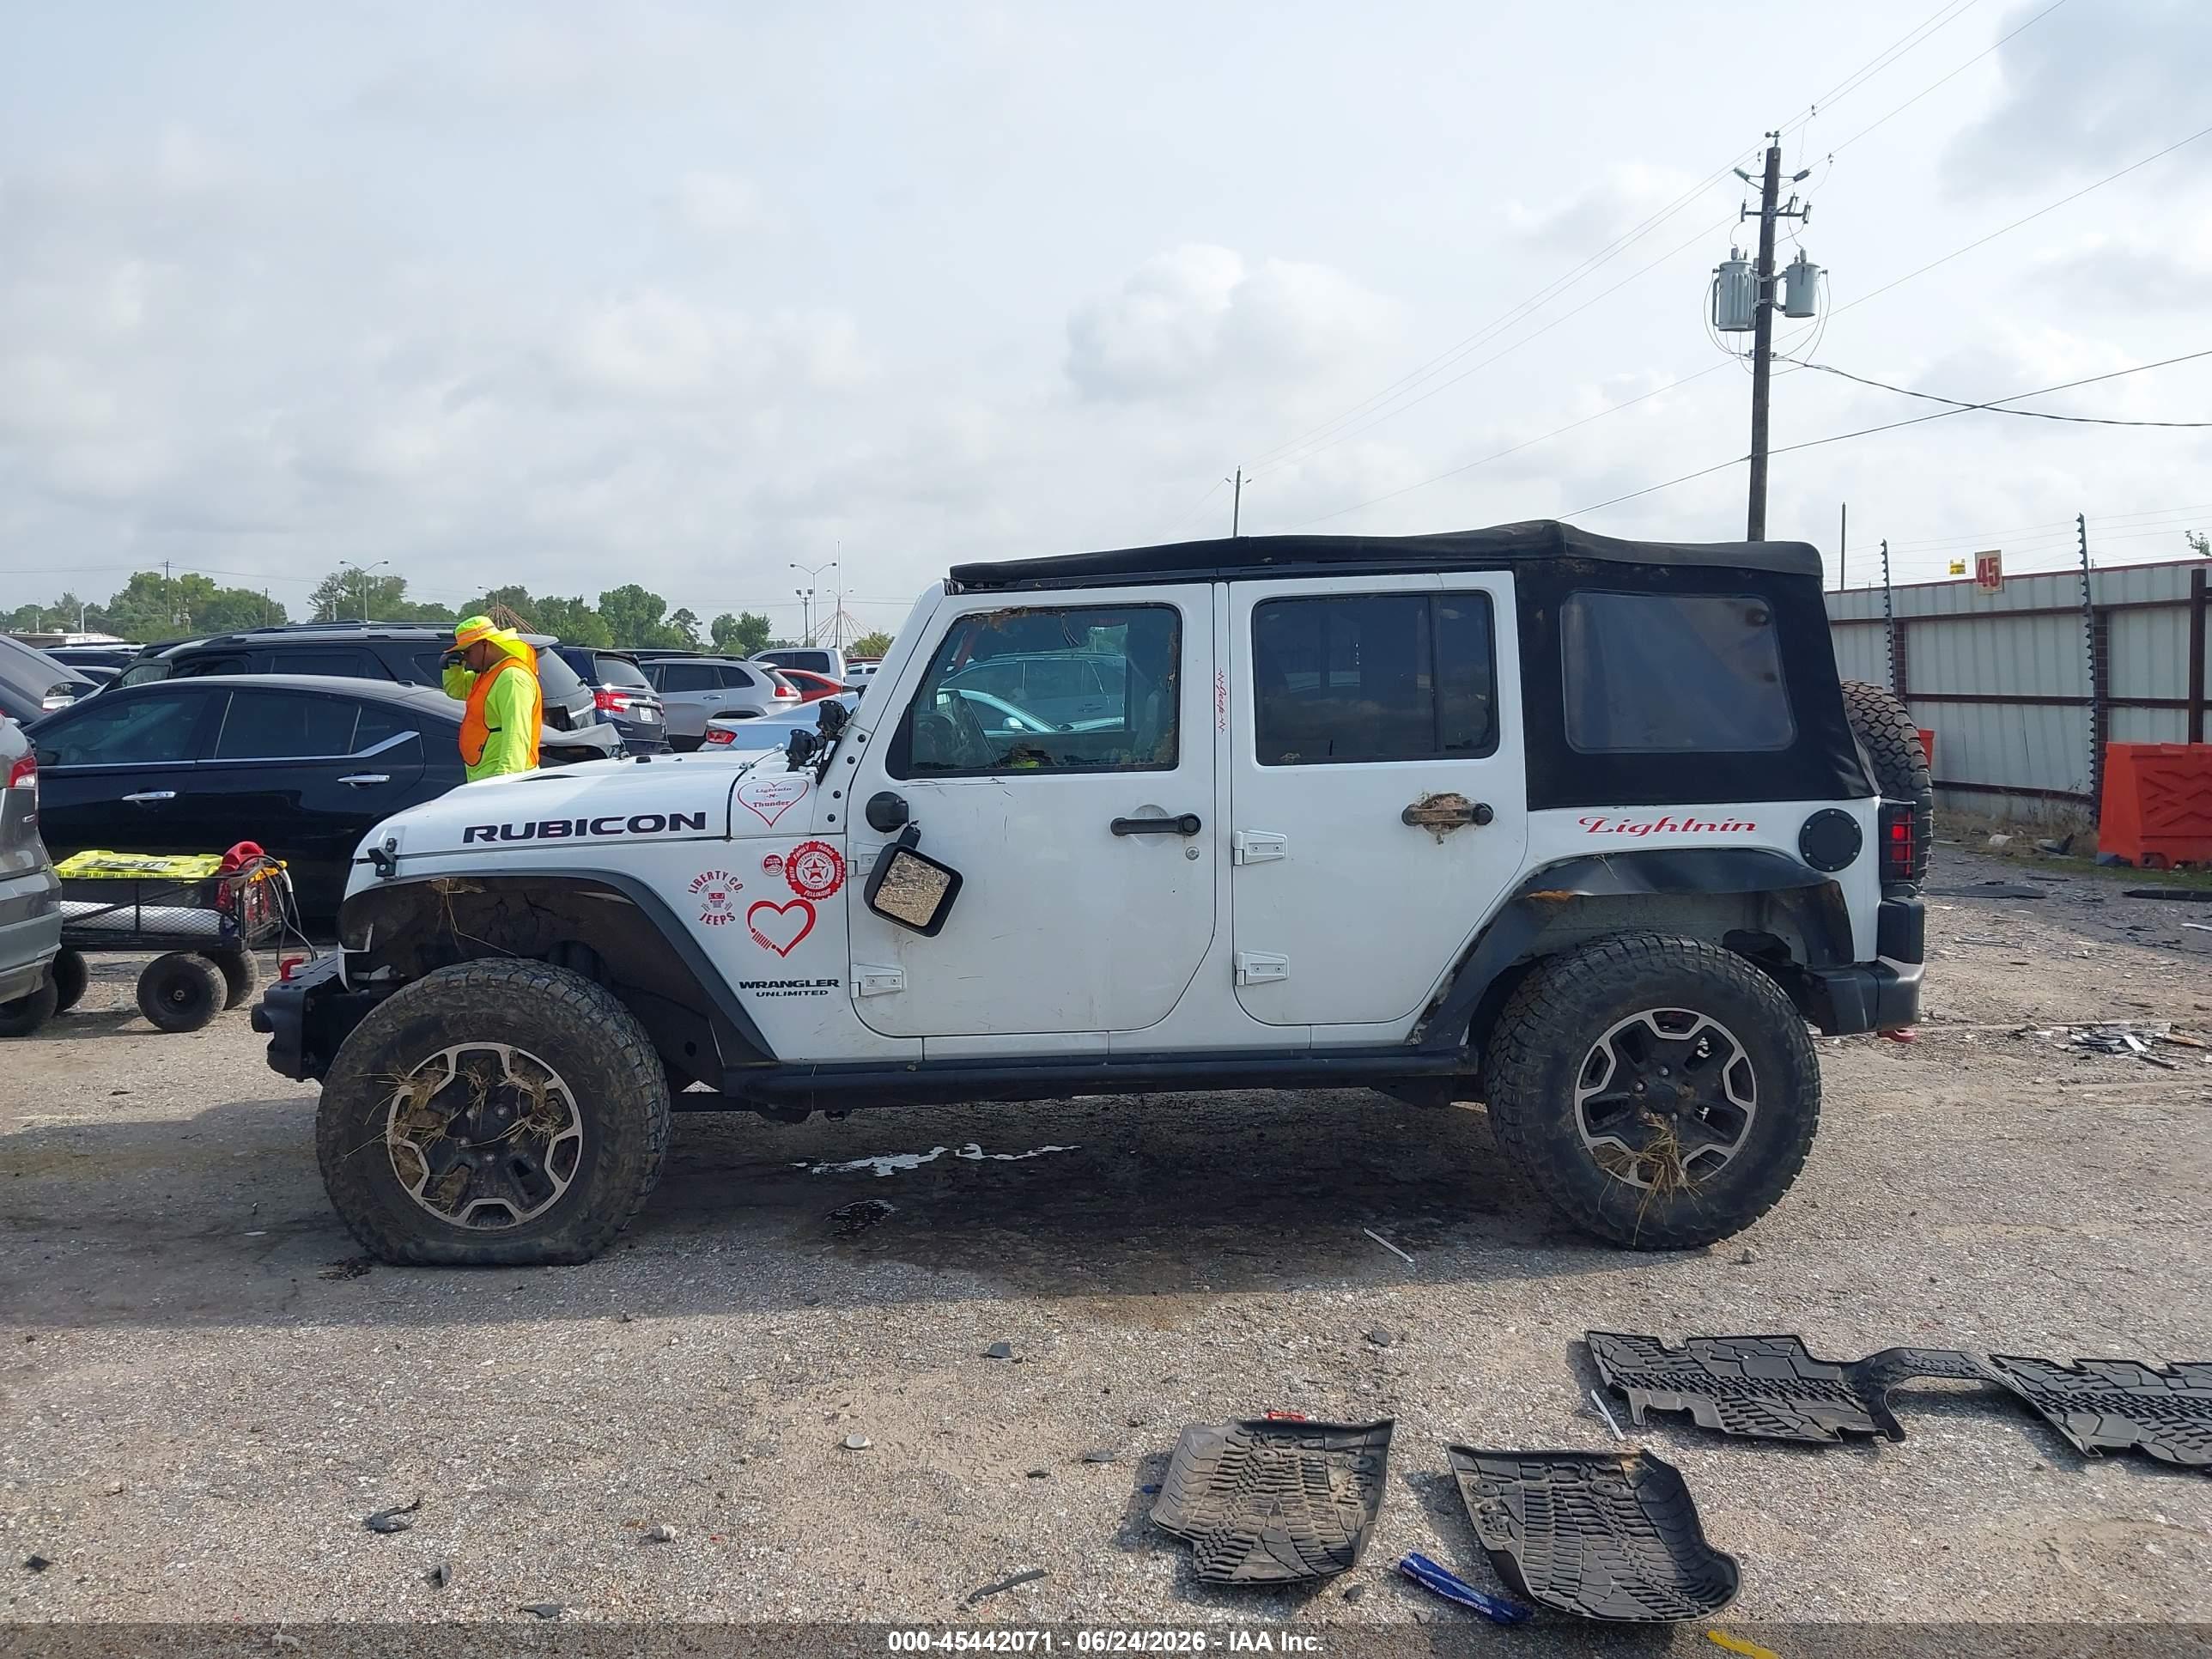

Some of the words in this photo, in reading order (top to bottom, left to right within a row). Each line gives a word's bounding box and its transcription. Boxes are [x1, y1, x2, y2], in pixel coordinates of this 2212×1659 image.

[1977, 557, 2000, 587] 45
[463, 812, 706, 843] RUBICON
[1578, 816, 1757, 836] Lightnin
[793, 844, 810, 860] FAMILY
[688, 871, 728, 894] LIBERTY
[729, 877, 744, 893] CO.
[699, 912, 736, 926] JEEPS
[739, 979, 841, 989] WRANGLER
